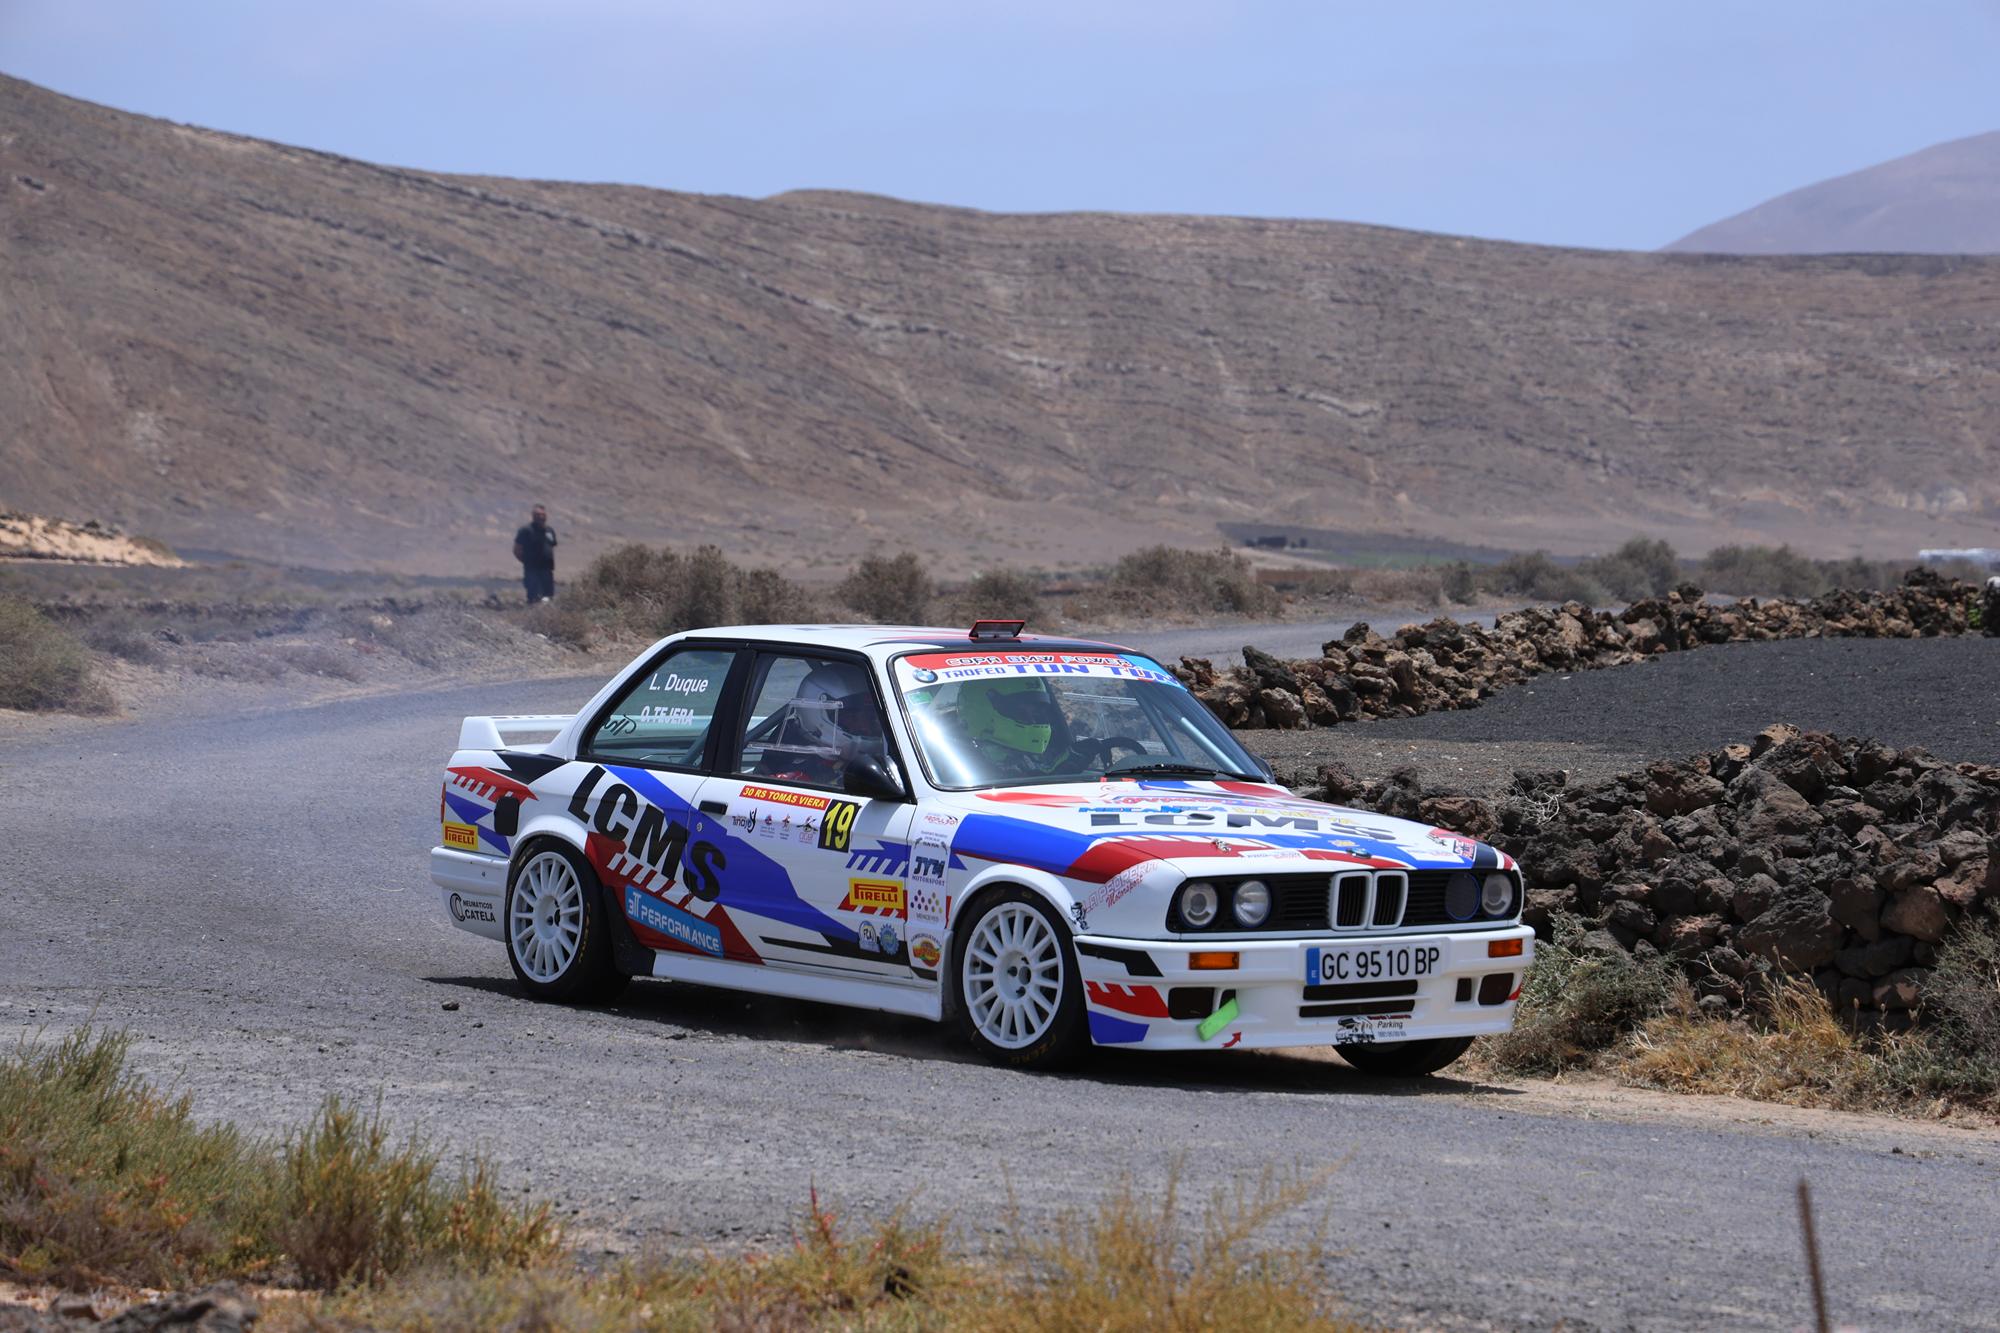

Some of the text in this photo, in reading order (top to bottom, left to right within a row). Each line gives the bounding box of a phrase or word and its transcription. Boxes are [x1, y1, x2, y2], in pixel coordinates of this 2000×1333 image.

[946, 656, 1002, 666] COPA
[1004, 655, 1054, 664] BMW
[942, 667, 1006, 678] TROFEO
[1008, 664, 1089, 674] TUN
[649, 673, 709, 696] L. Duque
[743, 787, 826, 808] 30 RS TOMÁS VIERA
[445, 826, 475, 845] PIRELLI
[568, 764, 727, 902] LCMS
[825, 802, 855, 849] 19
[1091, 812, 1397, 840] LCMS
[911, 875, 945, 887] MOTORSPORT
[1083, 861, 1159, 913] LA PEDRERA
[854, 883, 898, 903] PIRELLI
[465, 909, 496, 923] CATELA
[641, 904, 720, 952] PERFORMANCE
[1322, 947, 1440, 980] GC 9510 BP
[1311, 970, 1318, 978] E
[1377, 1020, 1404, 1032] Parking
